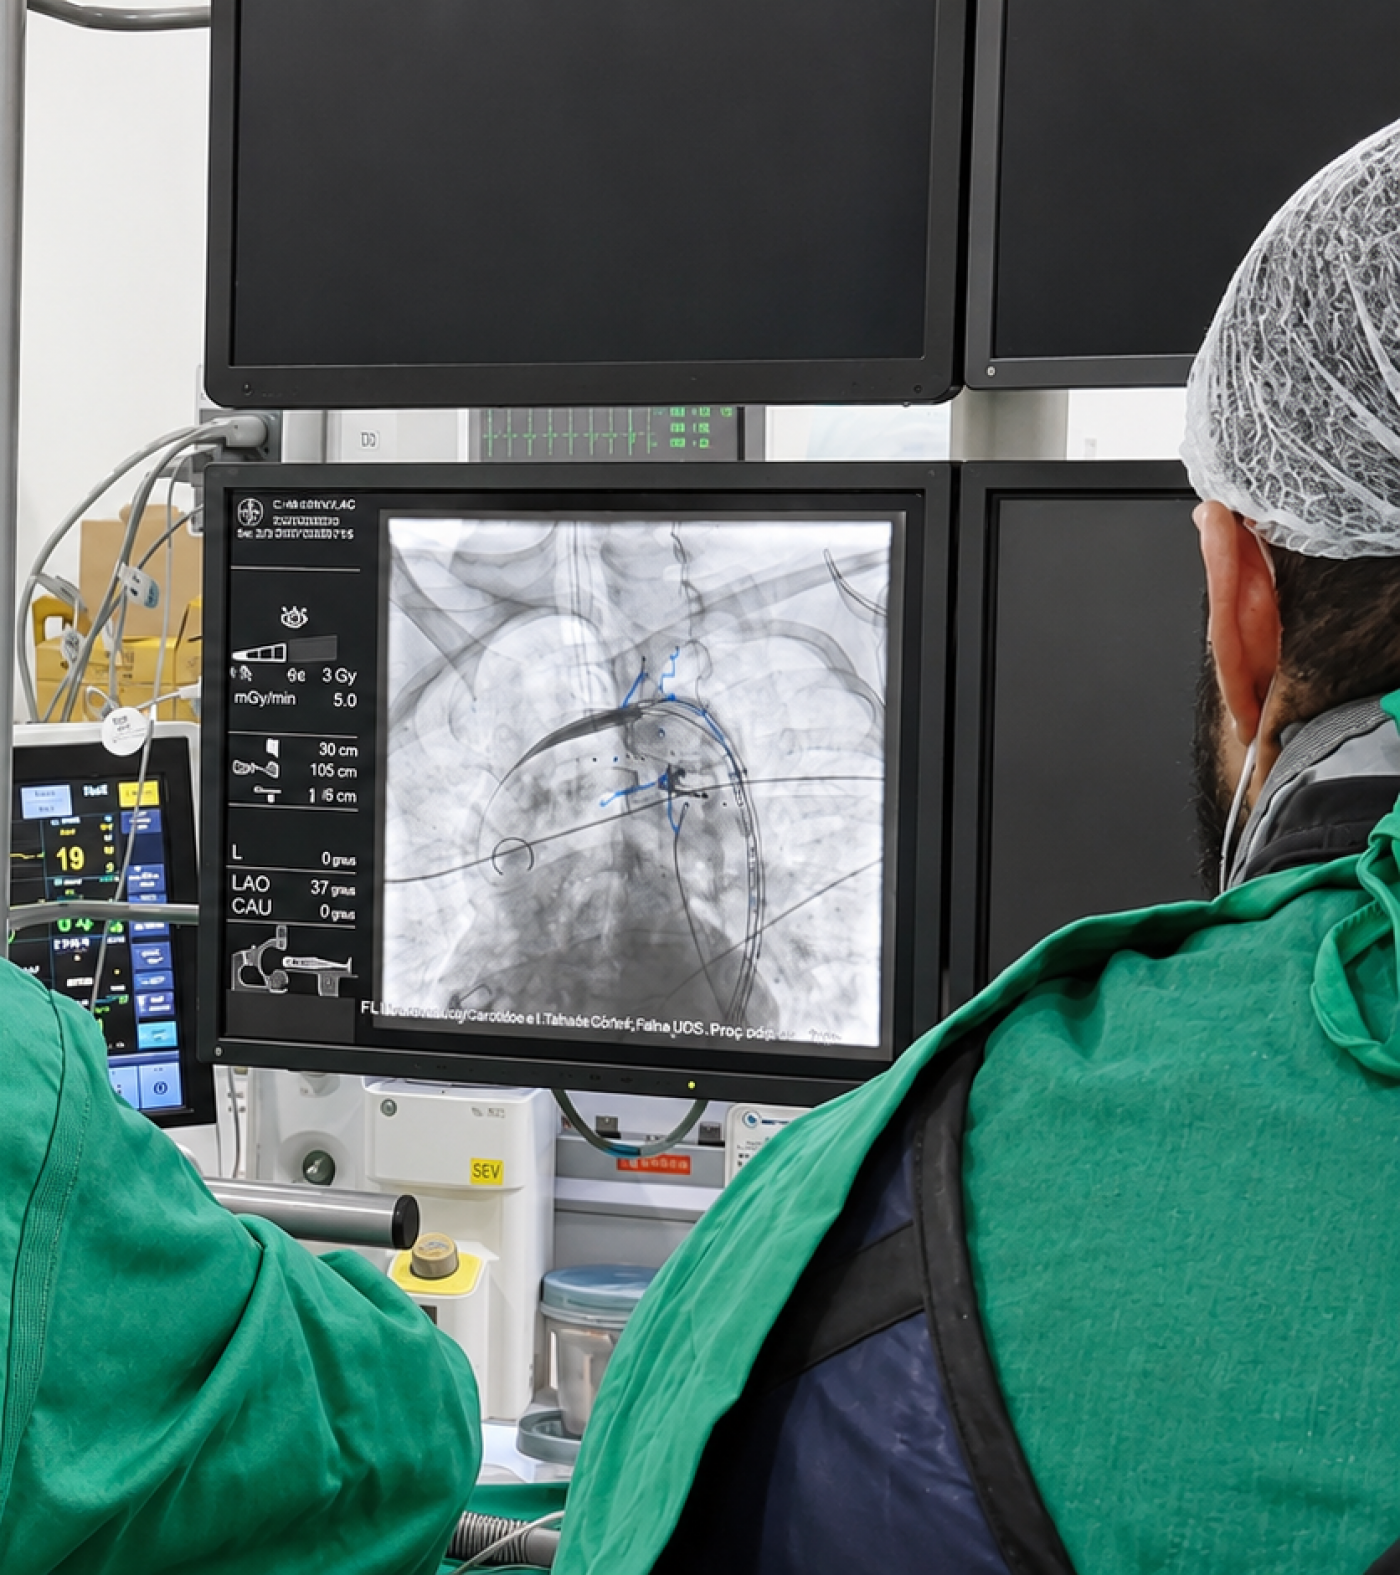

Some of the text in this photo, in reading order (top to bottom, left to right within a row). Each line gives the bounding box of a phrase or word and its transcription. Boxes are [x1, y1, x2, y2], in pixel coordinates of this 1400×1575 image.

[322, 667, 332, 682] 3
[335, 667, 357, 686] Gy
[233, 690, 358, 708] mGy/min 5.0
[319, 742, 358, 757] 30 cm
[309, 763, 358, 778] 105 cm
[336, 791, 358, 803] cm
[56, 846, 85, 872] 19
[232, 844, 243, 860] L
[321, 851, 331, 865] 0
[231, 874, 271, 892] LAO
[310, 879, 330, 895] 37
[231, 897, 272, 916] CAU
[319, 904, 330, 919] 0
[473, 1162, 500, 1179] SEV
